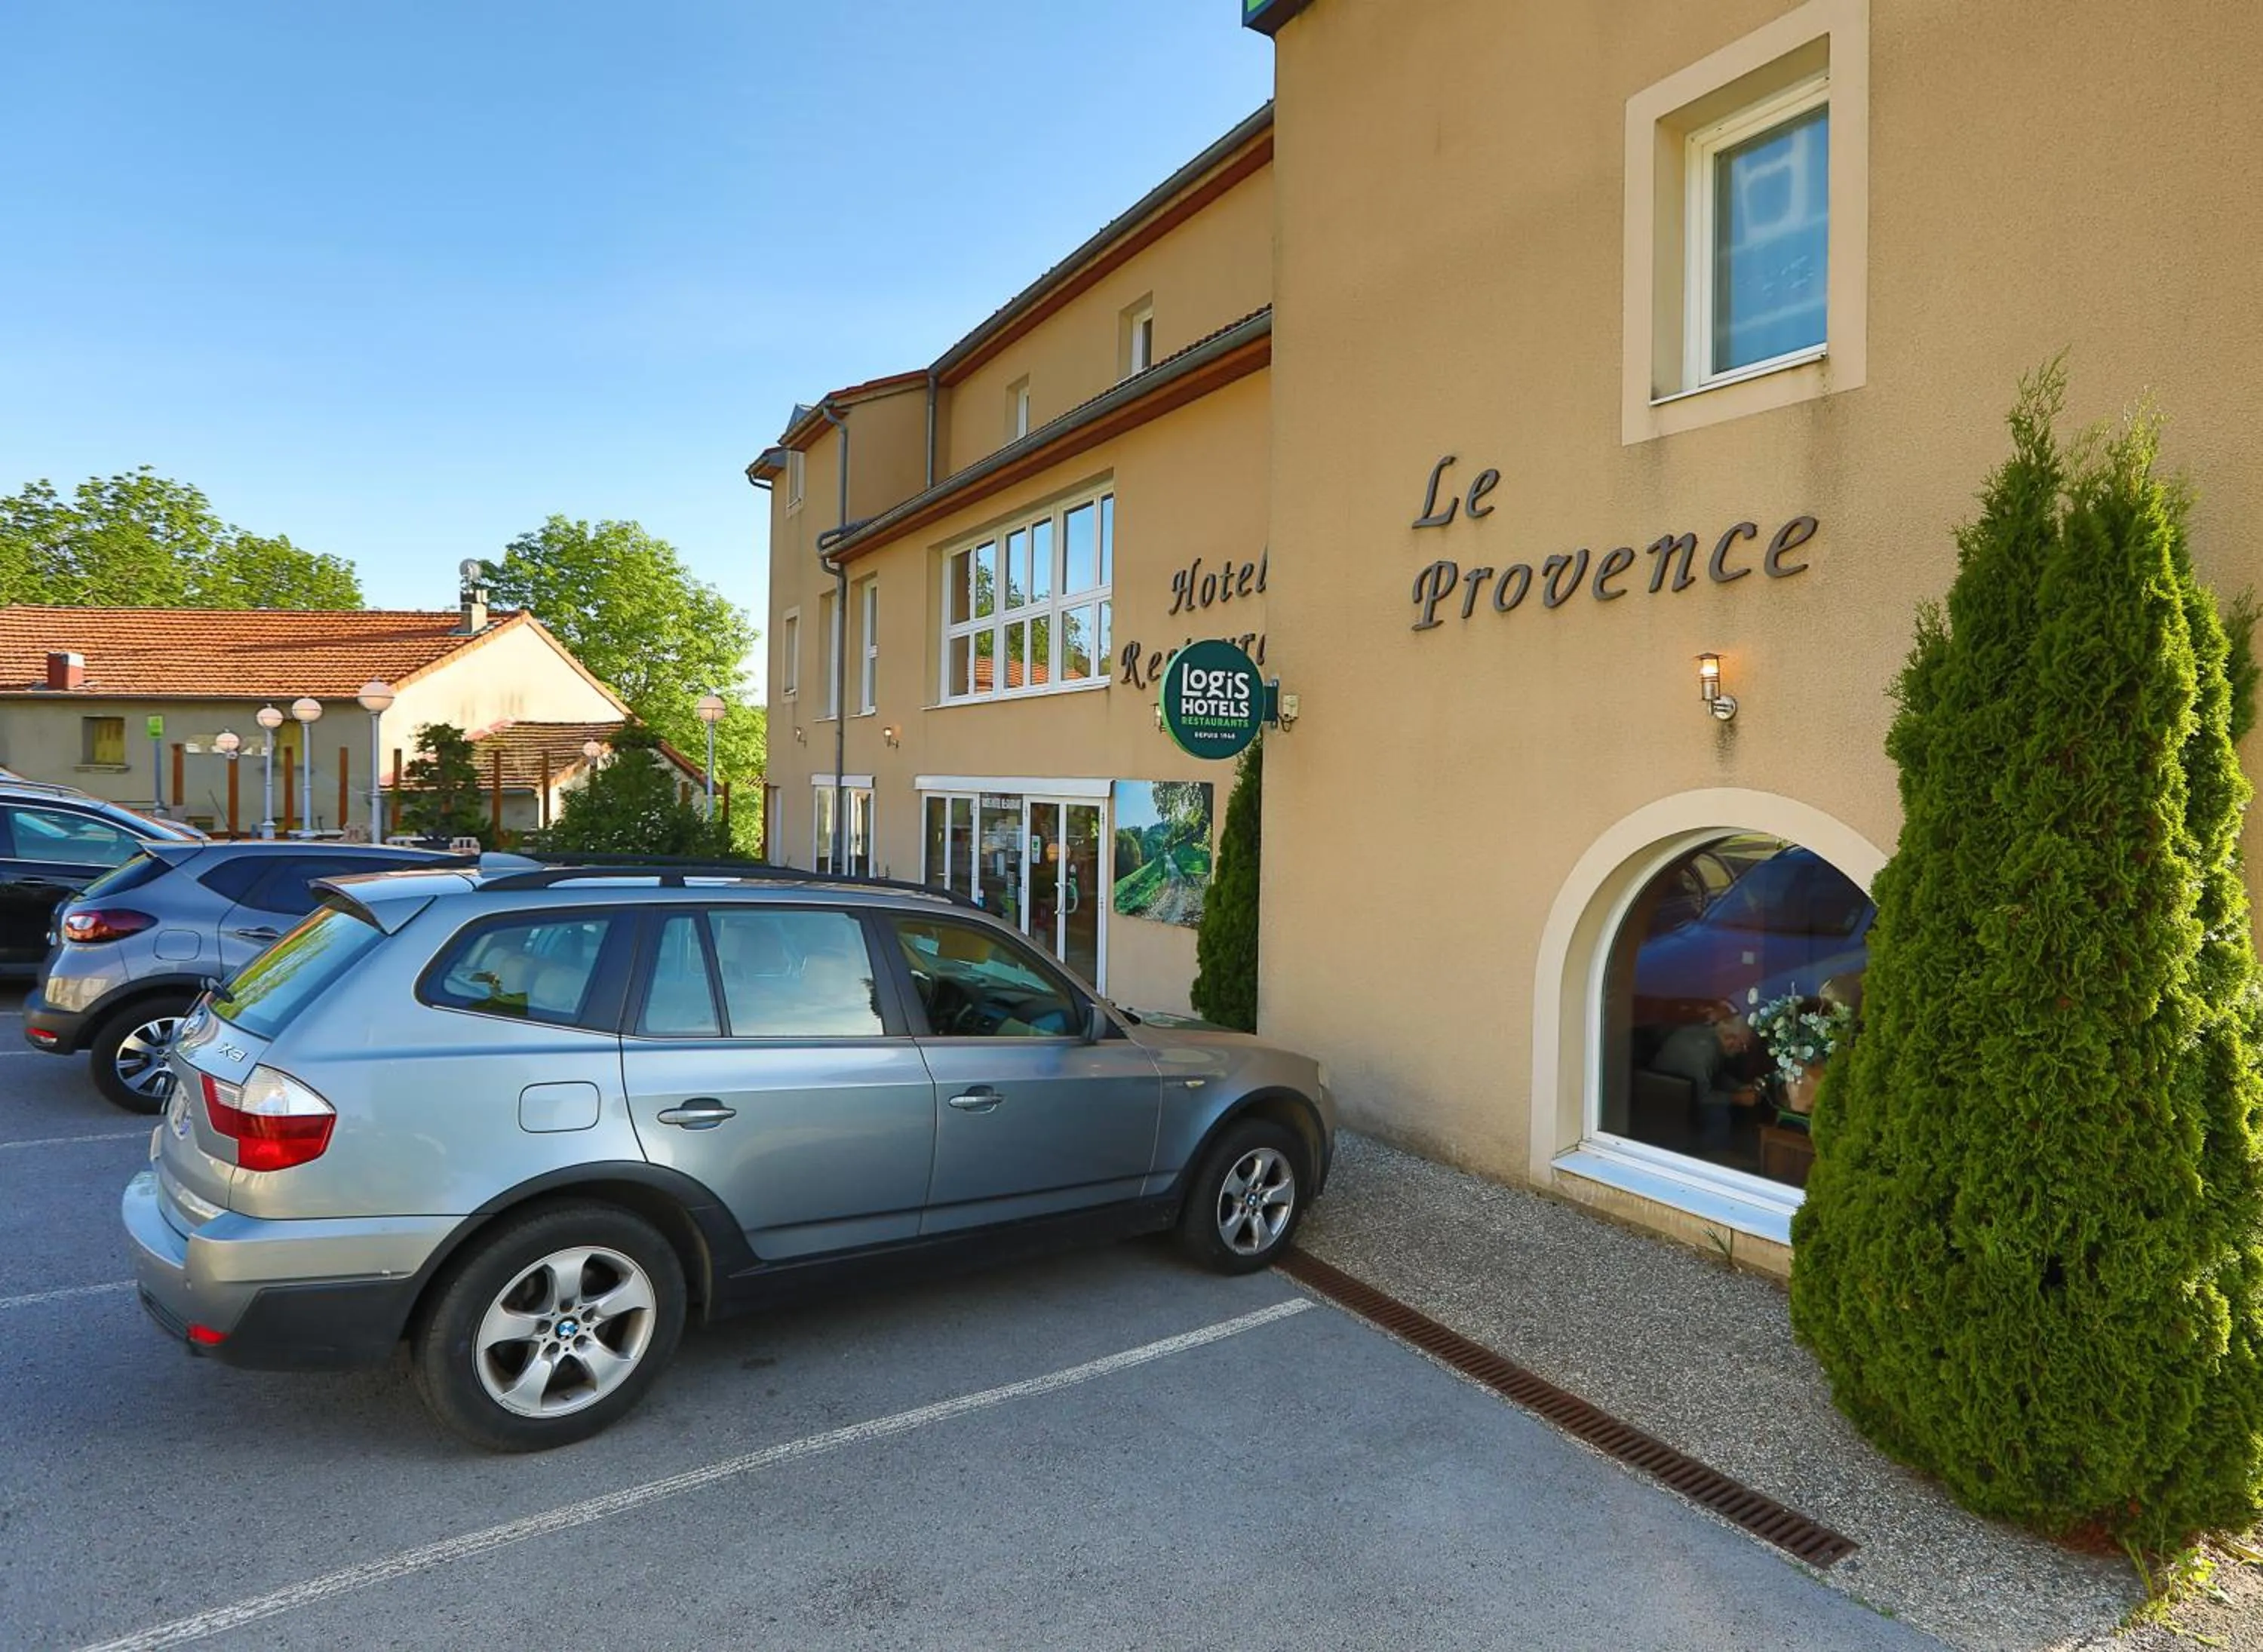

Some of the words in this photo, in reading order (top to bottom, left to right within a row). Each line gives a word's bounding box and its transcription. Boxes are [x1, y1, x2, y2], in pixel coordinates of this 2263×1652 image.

[1411, 455, 1500, 529] Le
[1168, 543, 1267, 616] Hotel
[1411, 515, 1819, 631] Provence
[1181, 698, 1250, 718] HOTELS
[1181, 717, 1249, 728] RESTAURANTS
